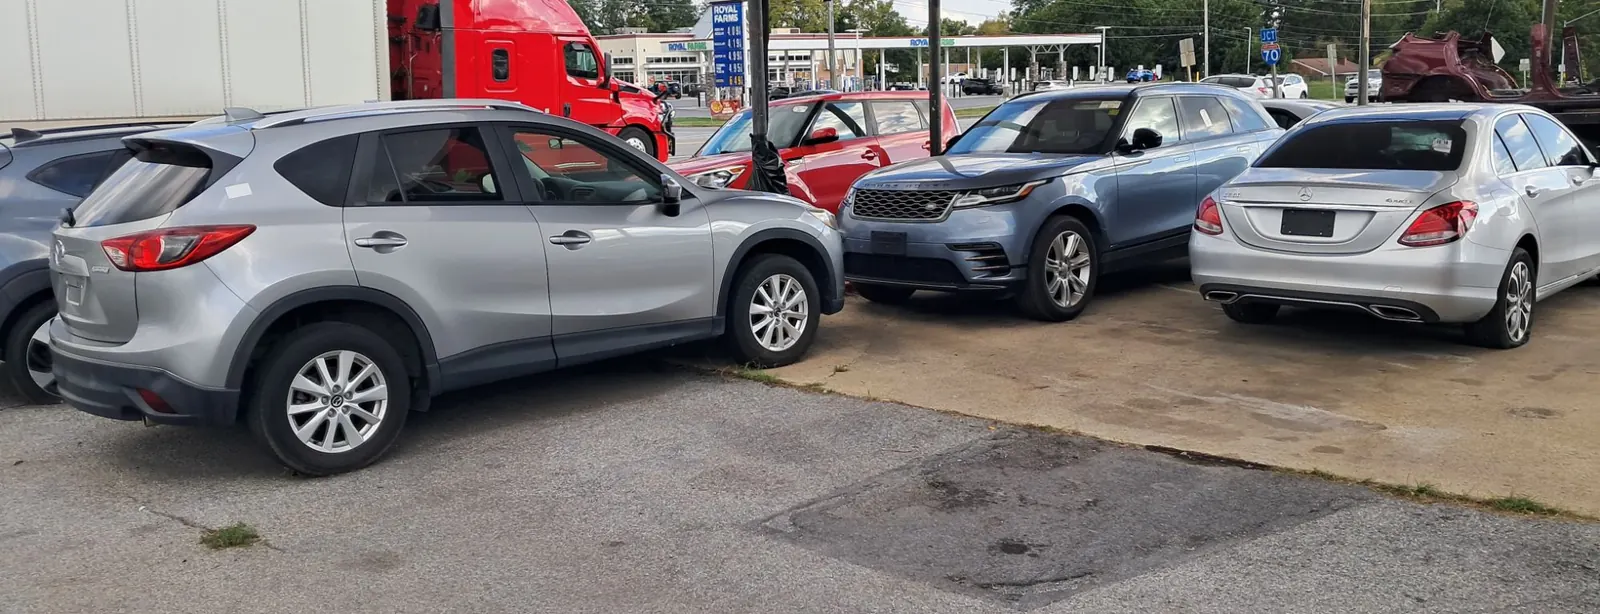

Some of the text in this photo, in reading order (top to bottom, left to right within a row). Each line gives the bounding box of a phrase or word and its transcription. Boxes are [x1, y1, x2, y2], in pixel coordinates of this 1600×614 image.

[714, 4, 738, 14] ROYAL
[714, 13, 739, 23] FARMS
[1262, 31, 1275, 40] JCT
[668, 42, 687, 51] ROYAL
[687, 42, 707, 50] FARMS
[1263, 50, 1279, 62] 70
